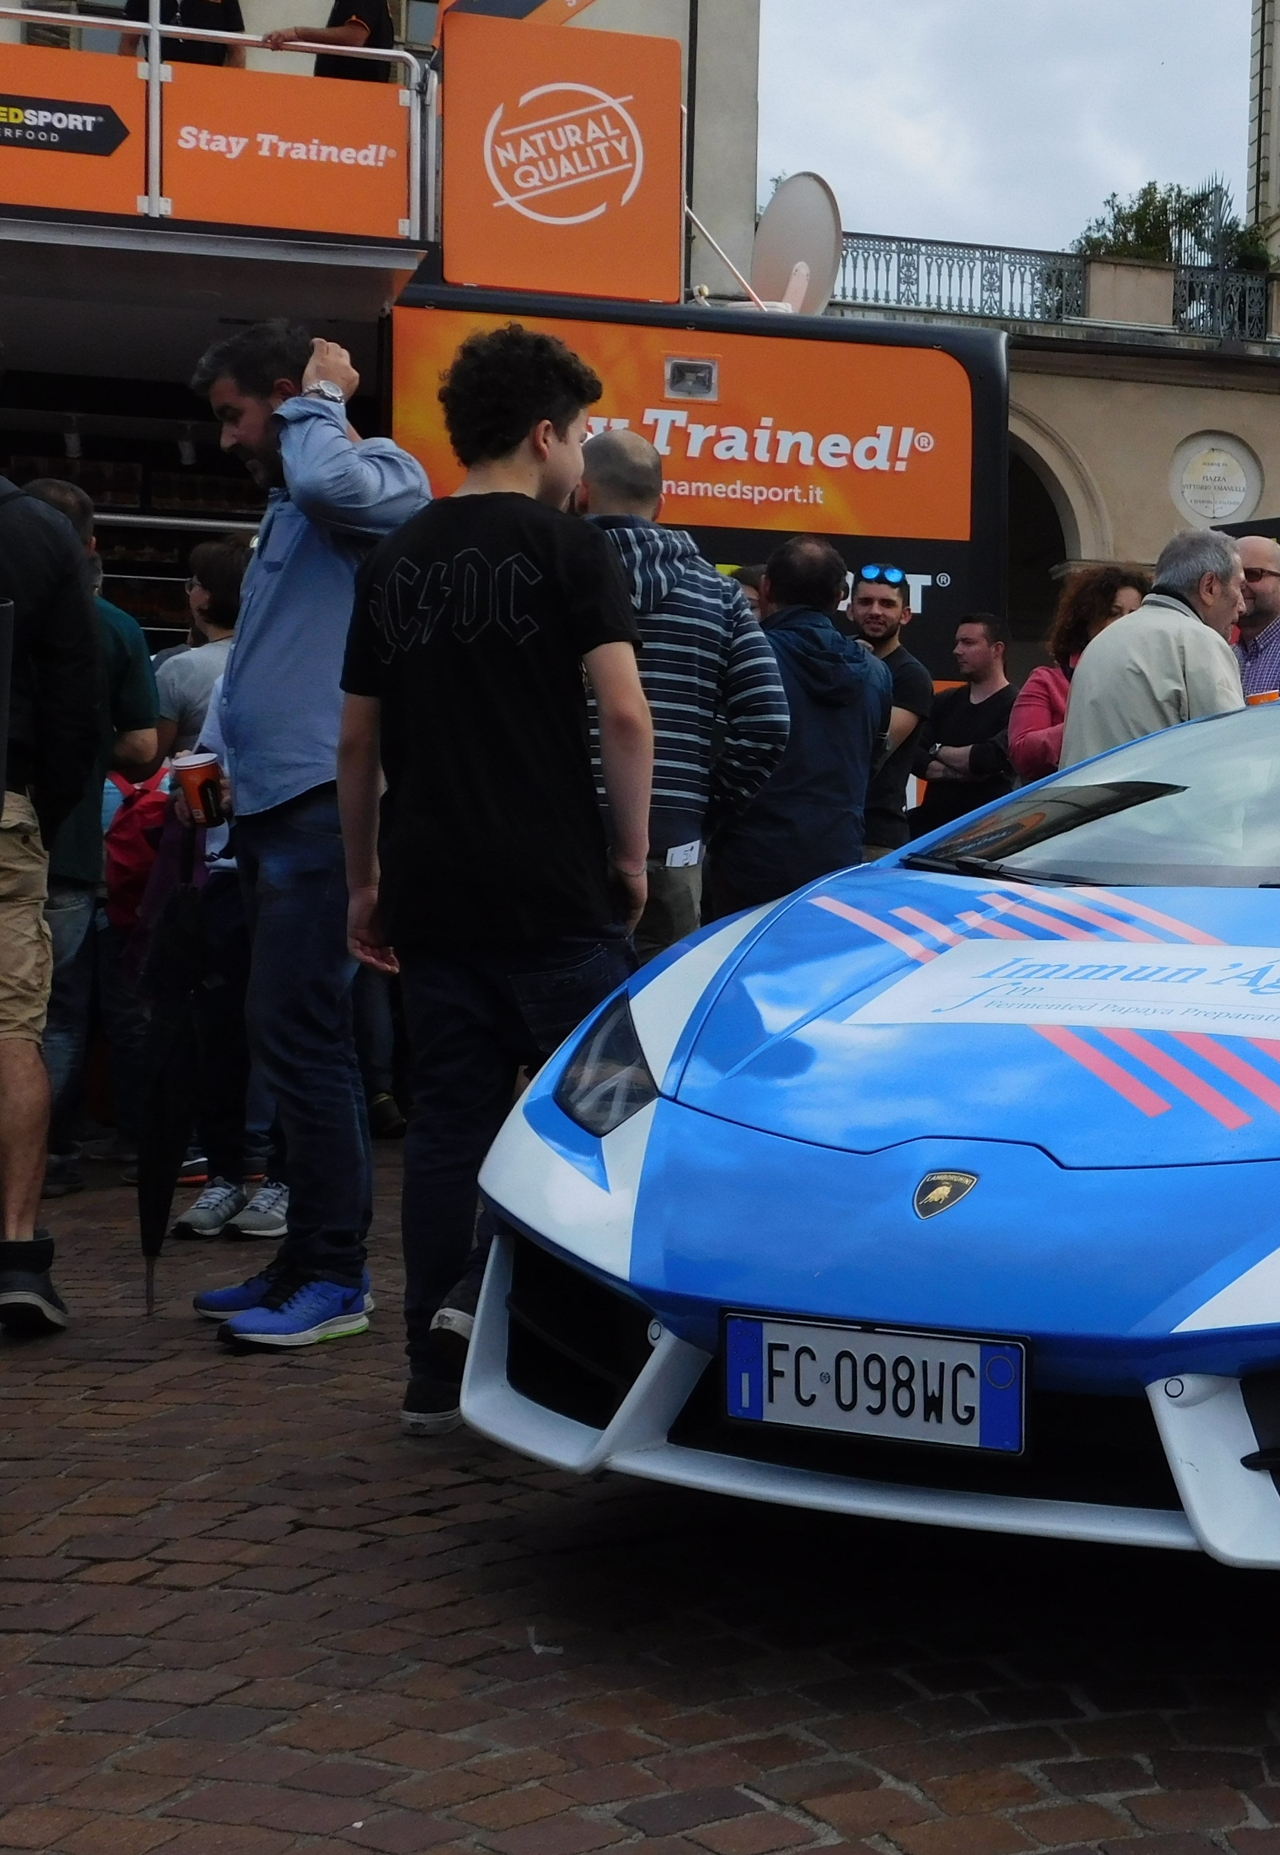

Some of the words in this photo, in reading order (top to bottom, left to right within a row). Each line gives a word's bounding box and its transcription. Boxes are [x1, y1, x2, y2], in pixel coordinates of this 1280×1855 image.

[177, 126, 248, 159] Stay
[494, 114, 621, 168] NATURAL
[513, 136, 628, 188] QUALITY
[984, 1000, 1098, 1012] Fermented
[1098, 1004, 1174, 1016] Papaya
[926, 1174, 973, 1186] LAMBORGHINI
[767, 1342, 817, 1407] FC
[834, 1350, 976, 1426] 098WG
